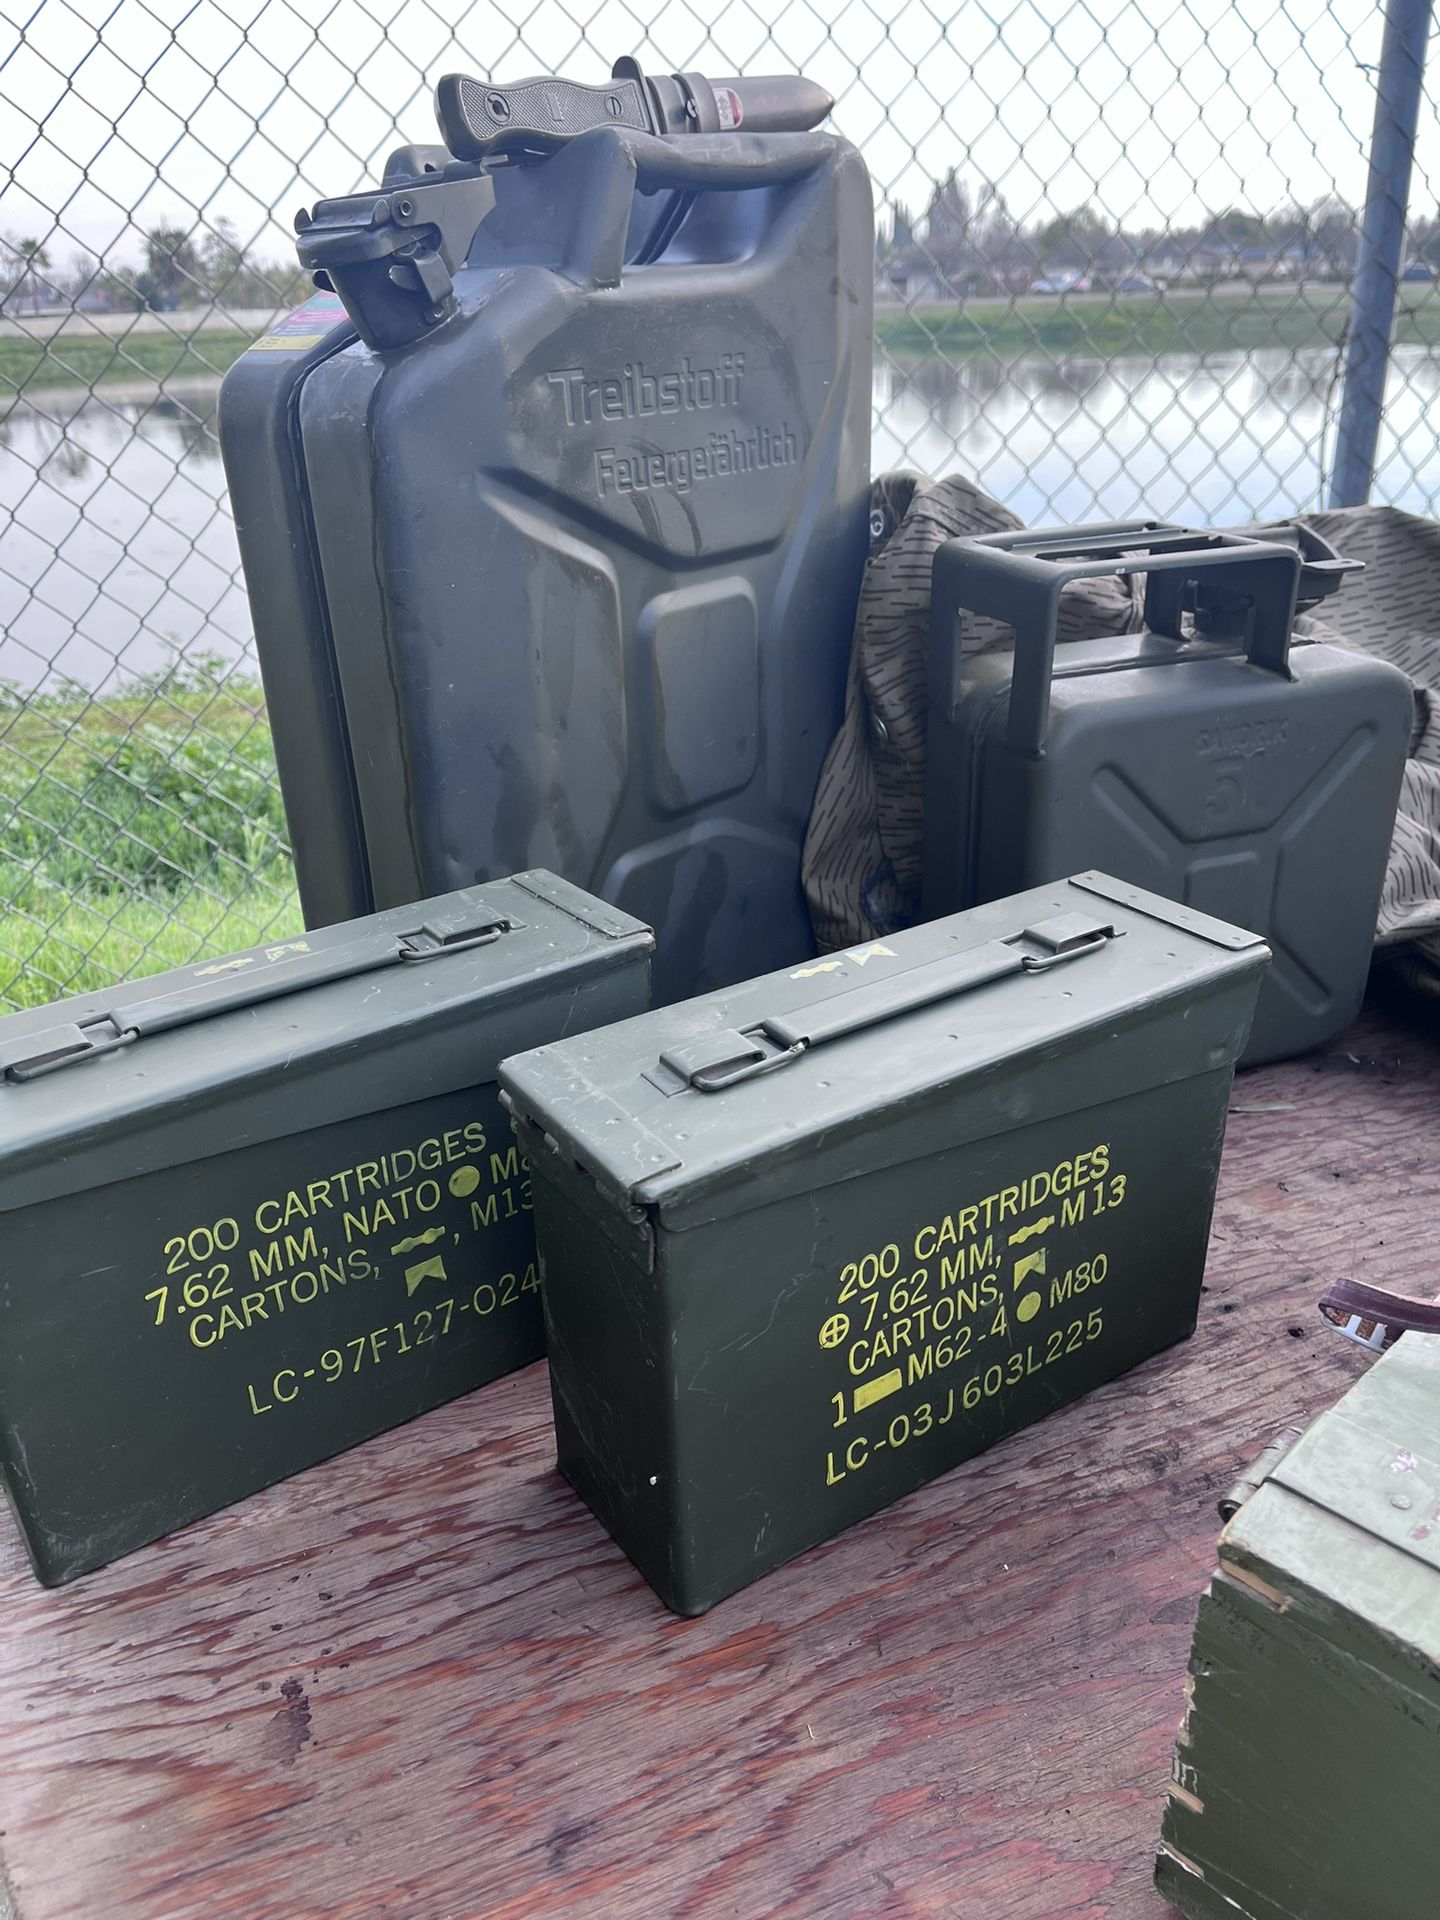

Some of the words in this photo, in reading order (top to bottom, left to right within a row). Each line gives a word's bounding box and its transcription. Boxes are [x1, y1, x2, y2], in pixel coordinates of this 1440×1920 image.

[547, 352, 746, 427] Treibstoff
[594, 421, 797, 498] Feuergefährlich
[144, 1263, 234, 1327] 7.62
[249, 1226, 329, 1282] MM,
[343, 1179, 442, 1243] NATO
[164, 1217, 240, 1275] 200
[255, 1122, 487, 1235] CARTRIDGES
[837, 1243, 900, 1304] 200
[914, 1144, 1111, 1261] CARTRIDGES
[860, 1268, 929, 1331] 7.62
[940, 1235, 1002, 1290] MM,
[1060, 1174, 1127, 1228] M13
[189, 1248, 381, 1349] CARTONS,
[248, 1262, 541, 1415] LC-97F127-024
[831, 1391, 848, 1428] 1
[907, 1305, 1007, 1386] M62-4
[1049, 1253, 1108, 1309] M80
[848, 1274, 1005, 1376] CARTONS,
